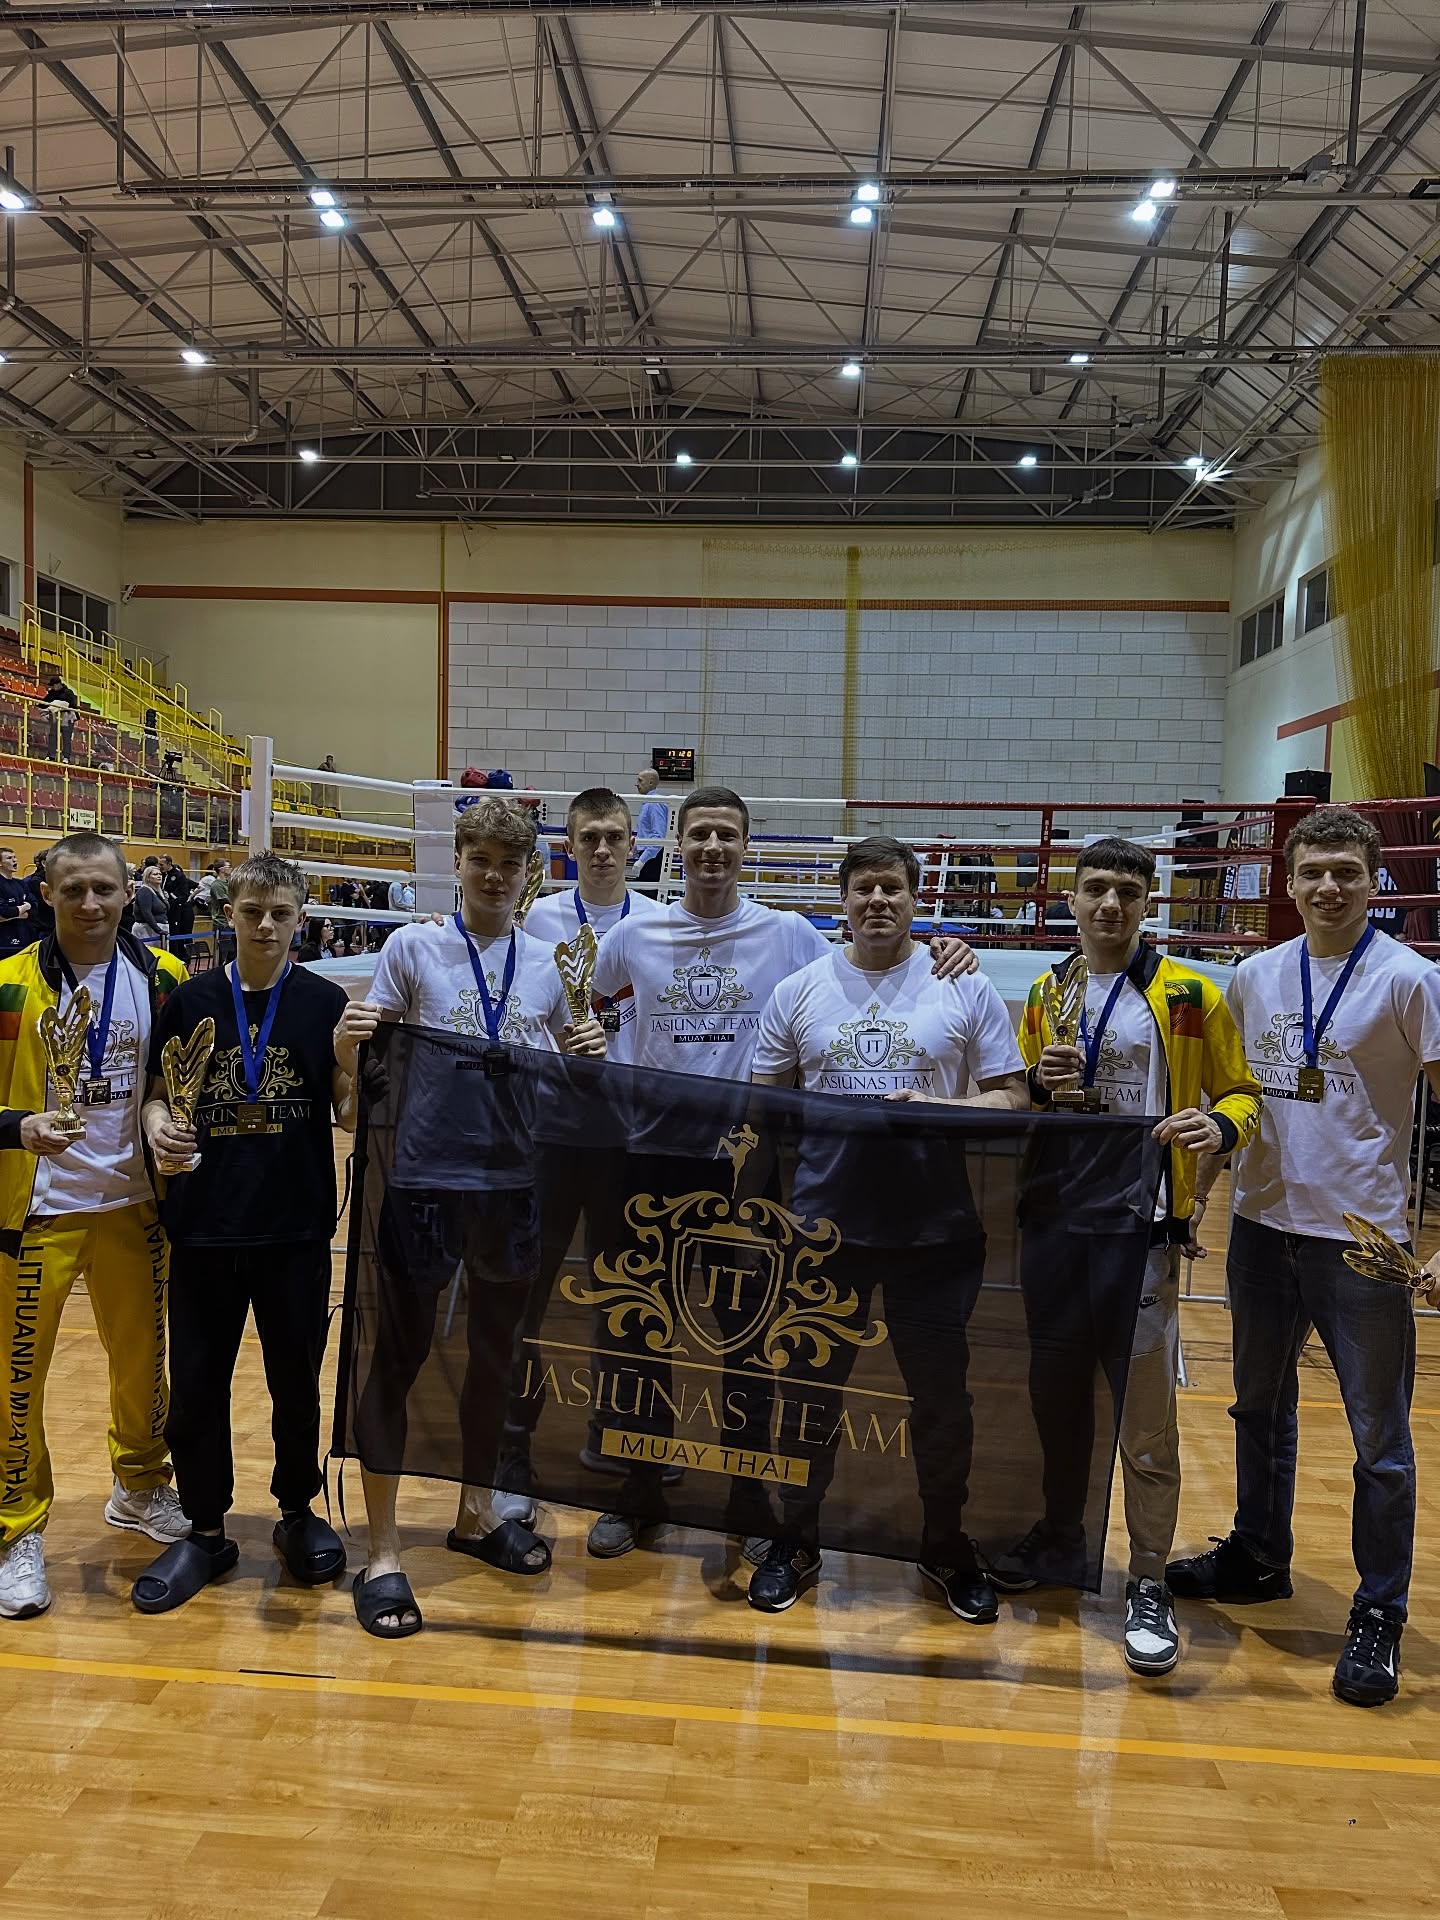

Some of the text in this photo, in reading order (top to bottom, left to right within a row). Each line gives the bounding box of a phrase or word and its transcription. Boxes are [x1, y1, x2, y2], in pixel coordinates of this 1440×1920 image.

[698, 984, 713, 996] JT
[651, 1016, 760, 1033] JASIŪNAS TEAM
[679, 1034, 705, 1042] MUAY
[865, 1039, 883, 1054] JT
[890, 1076, 935, 1089] TEAM
[1266, 1088, 1288, 1098] MUAY
[268, 1105, 311, 1119] TEAM
[699, 1265, 758, 1312] JT
[10, 1246, 44, 1384] LITHUANIA
[519, 1359, 910, 1459] JASIŪNAS TEAM
[619, 1433, 791, 1480] MUAY THAI
